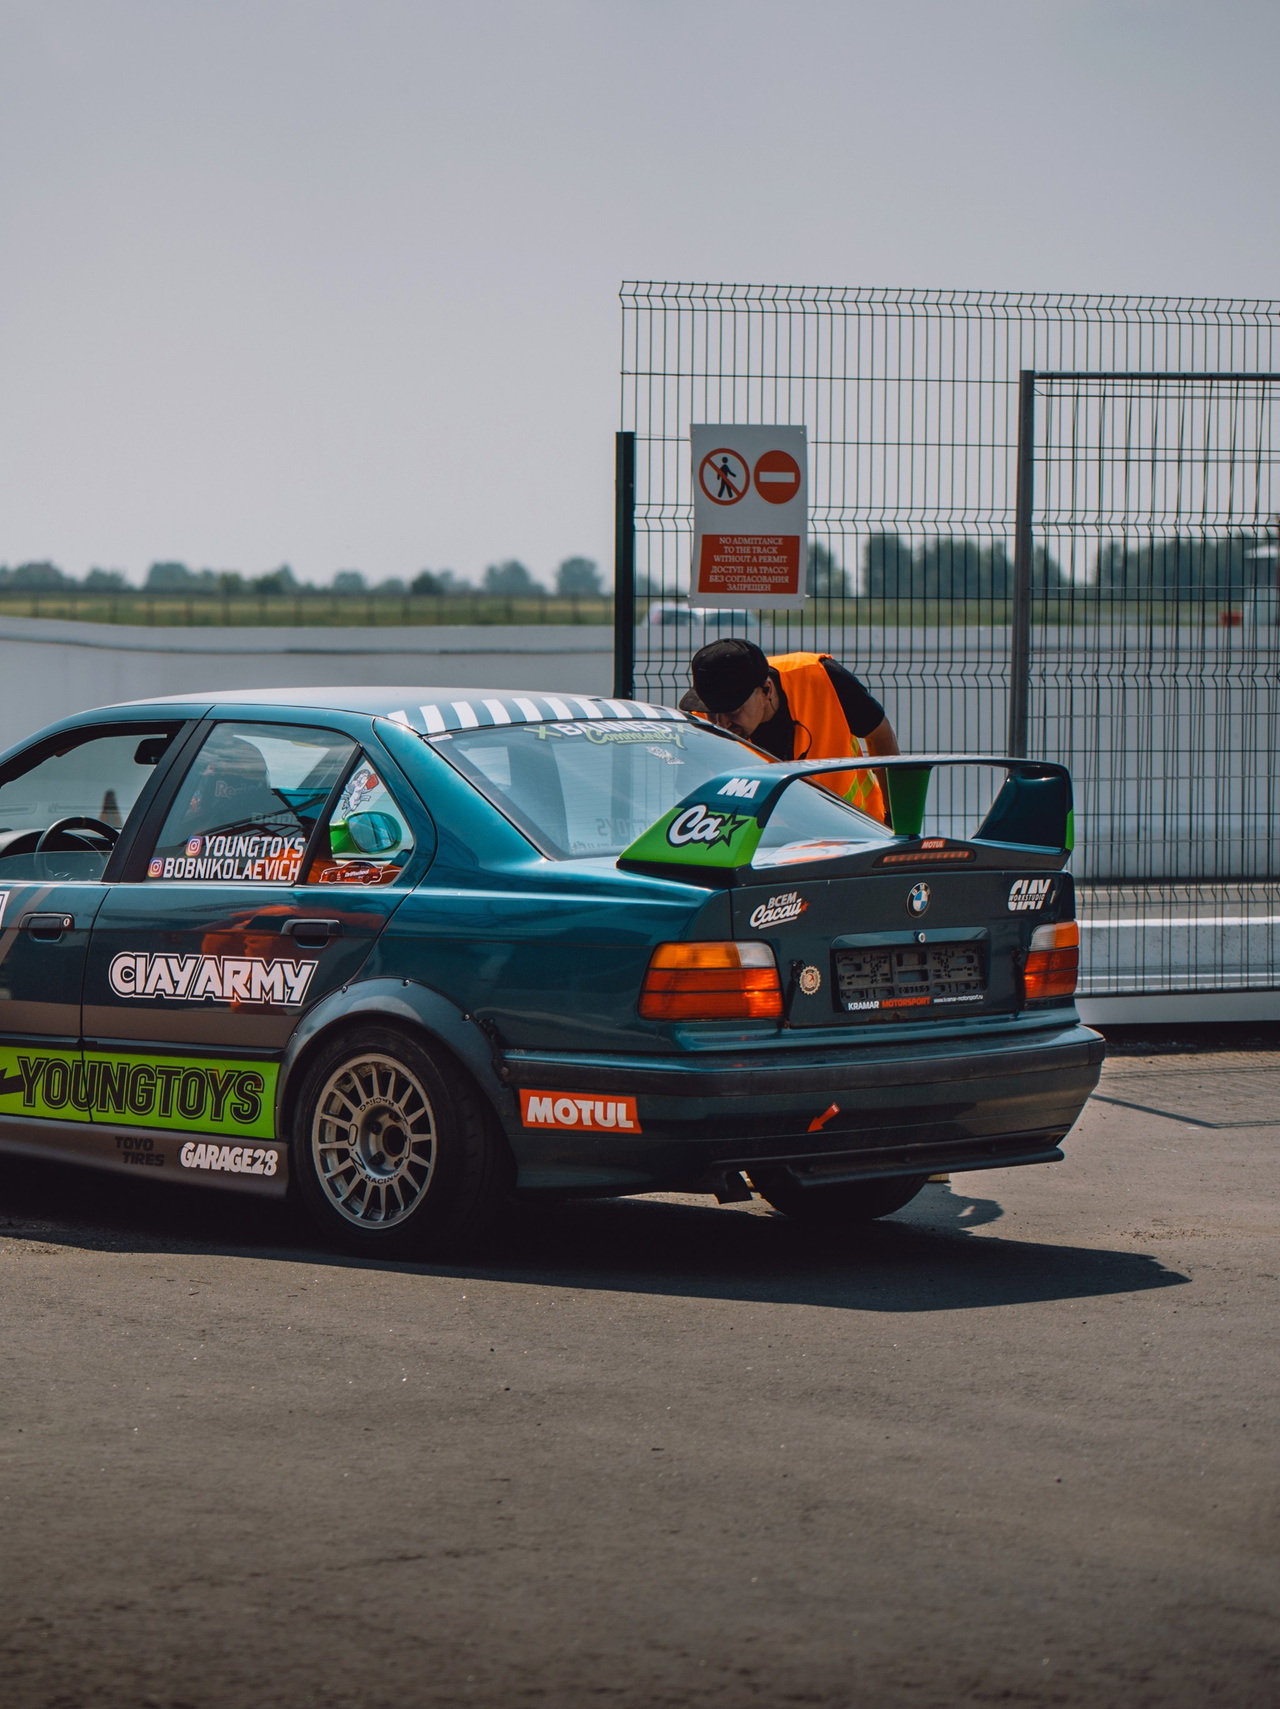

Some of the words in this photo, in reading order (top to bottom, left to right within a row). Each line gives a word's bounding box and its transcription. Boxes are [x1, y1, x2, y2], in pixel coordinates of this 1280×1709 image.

[719, 537, 732, 545] NO
[733, 537, 783, 546] ADMITTANCE
[723, 546, 735, 554] TO
[735, 546, 751, 554] THE
[752, 546, 778, 554] TRACK
[713, 555, 751, 563] WITHOUT
[751, 555, 758, 563] A
[710, 566, 744, 574] ДОСТУП
[746, 566, 758, 574] НА
[758, 566, 789, 574] ТРАССУ
[709, 574, 724, 583] БЕЗ
[725, 574, 790, 584] СОГЛАСОВАНИЯ
[726, 584, 771, 592] ЗАПРЕЩЕН
[203, 836, 306, 858] YOUNGTOYS
[922, 840, 945, 849] MOTUL
[163, 858, 303, 881] BOBNIKOLAEVICH
[848, 1001, 880, 1011] KRAMAR
[881, 996, 932, 1008] MOTORSPORT
[17, 1055, 265, 1125] YOUNGTOYS
[527, 1096, 634, 1128] MOTUL
[115, 1136, 154, 1151] TOYO
[122, 1151, 165, 1167] TIRES
